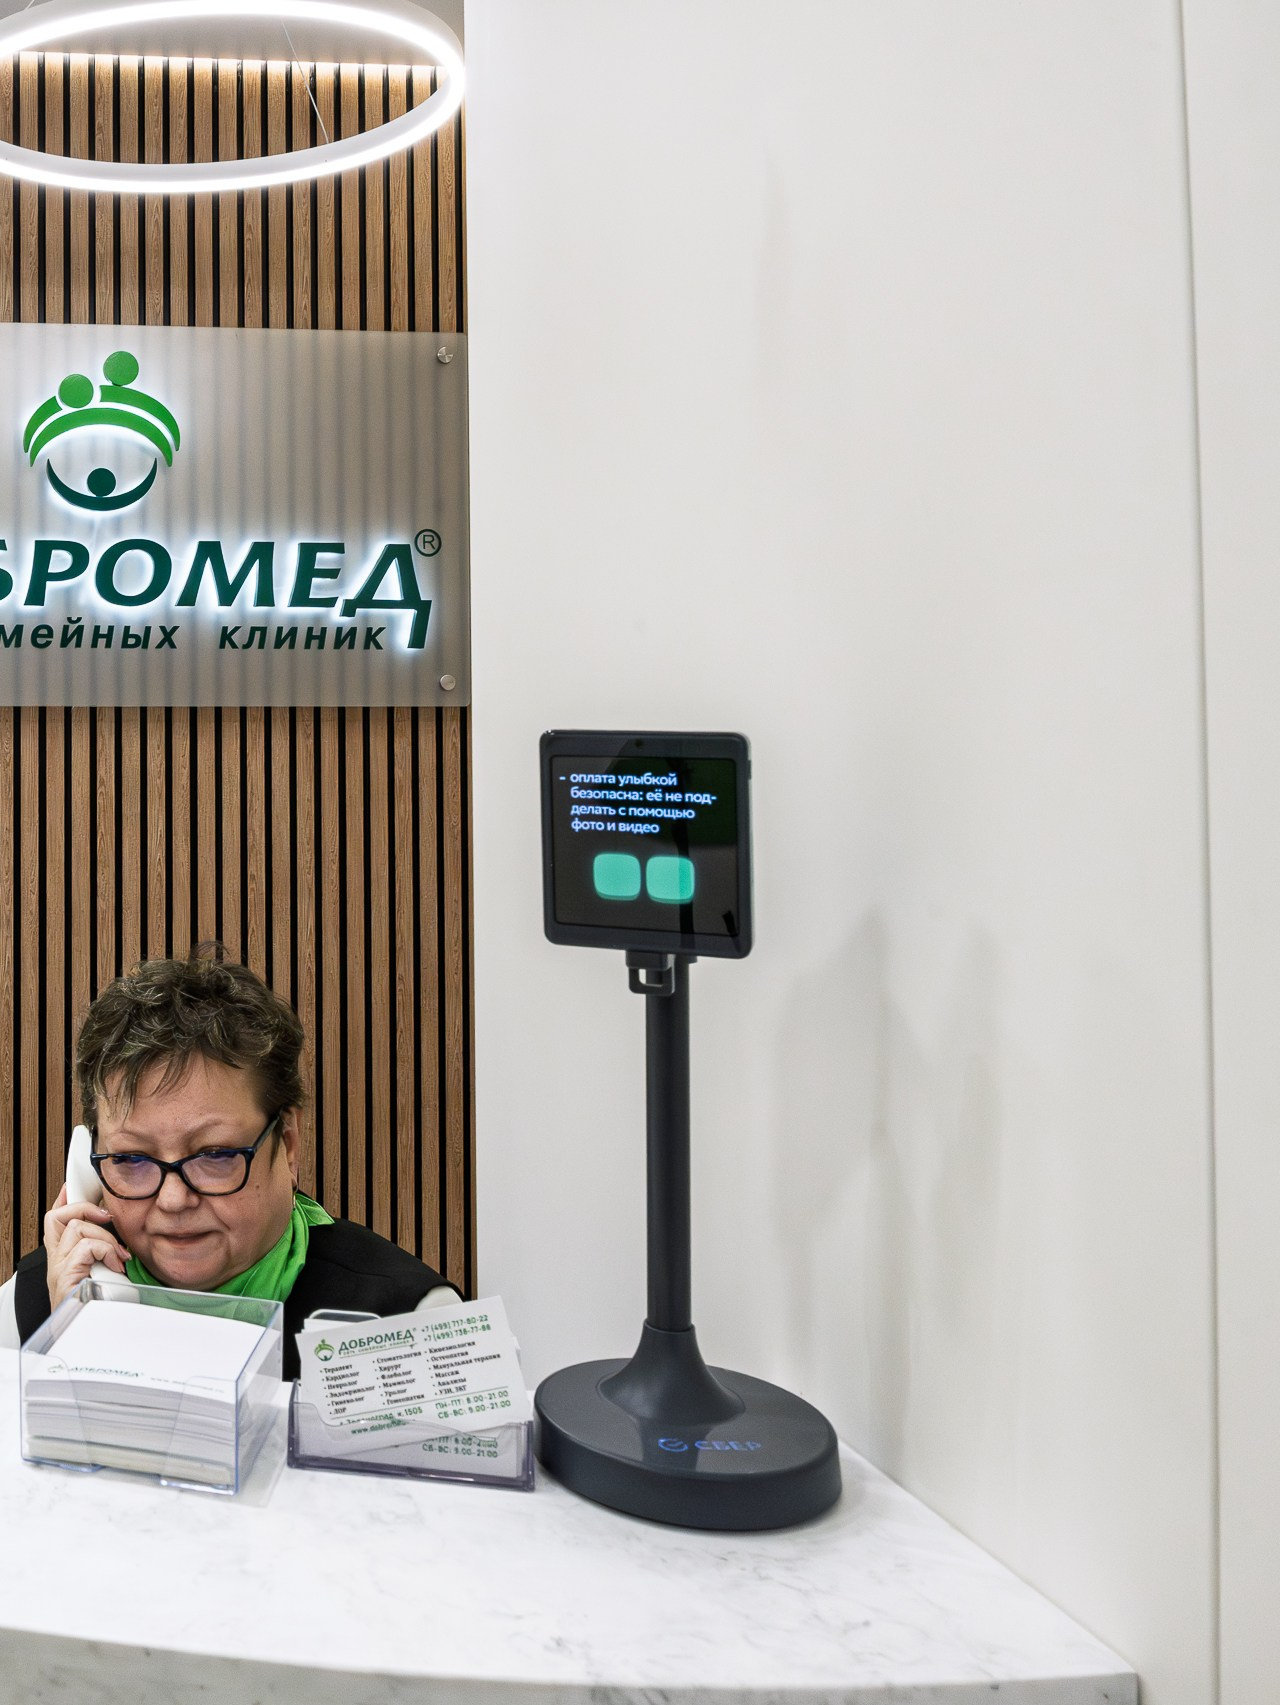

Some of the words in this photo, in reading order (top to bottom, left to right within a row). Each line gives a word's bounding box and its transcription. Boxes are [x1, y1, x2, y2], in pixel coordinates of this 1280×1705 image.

[218, 621, 387, 651] клиник
[570, 773, 616, 784] оплата
[618, 773, 677, 787] улыбкой
[570, 786, 644, 801] безопасна:
[645, 789, 662, 801] её
[665, 791, 683, 802] не
[685, 792, 718, 805] под-
[570, 804, 617, 816] делать
[618, 806, 626, 816] с
[628, 807, 696, 820] помощью
[571, 818, 605, 833] фото
[607, 822, 616, 831] и
[618, 822, 660, 834] видео
[338, 1329, 415, 1355] ДОБРОМЕД
[376, 1351, 422, 1364] Стоматология
[435, 1370, 460, 1379] Массаж
